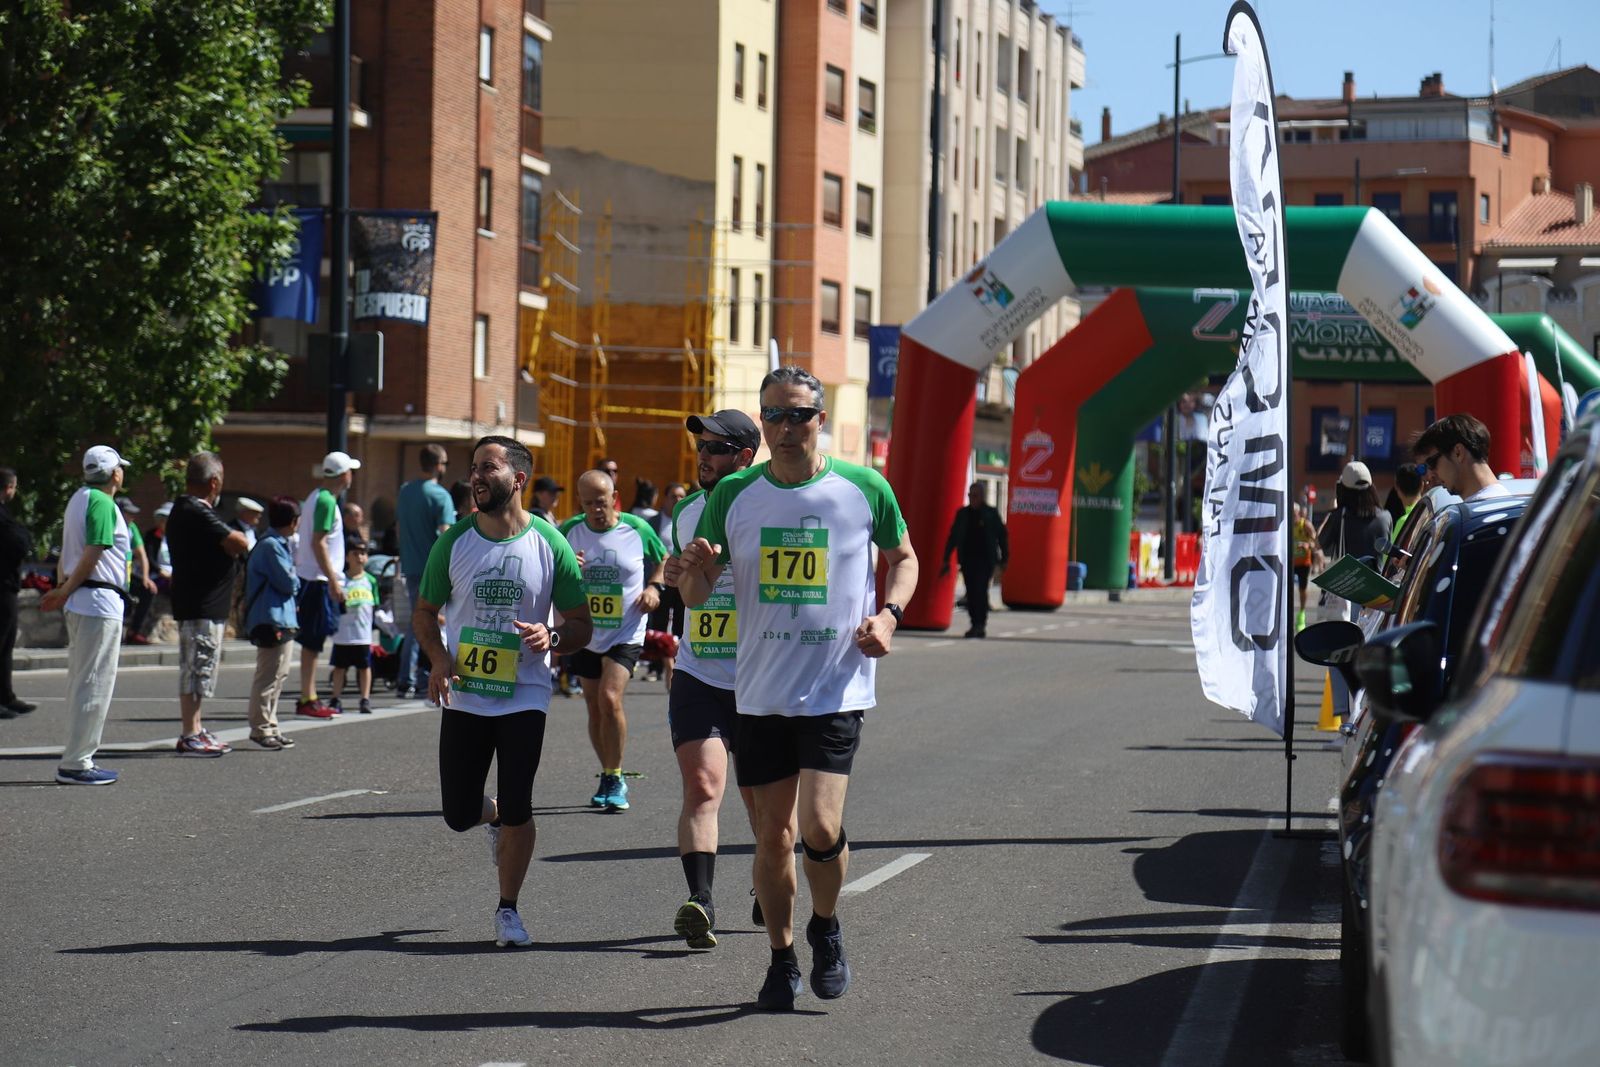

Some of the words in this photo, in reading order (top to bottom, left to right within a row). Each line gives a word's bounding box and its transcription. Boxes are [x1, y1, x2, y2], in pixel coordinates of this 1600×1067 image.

[404, 235, 431, 252] PP
[766, 549, 816, 580] 170
[477, 587, 488, 597] EL
[490, 587, 522, 600] CERCO
[781, 590, 800, 598] CAJA
[802, 590, 824, 599] RURAL
[590, 596, 614, 614] 66
[699, 612, 730, 638] 87
[464, 647, 498, 675] 46
[466, 681, 484, 689] CAJA
[485, 683, 511, 693] RURAL
